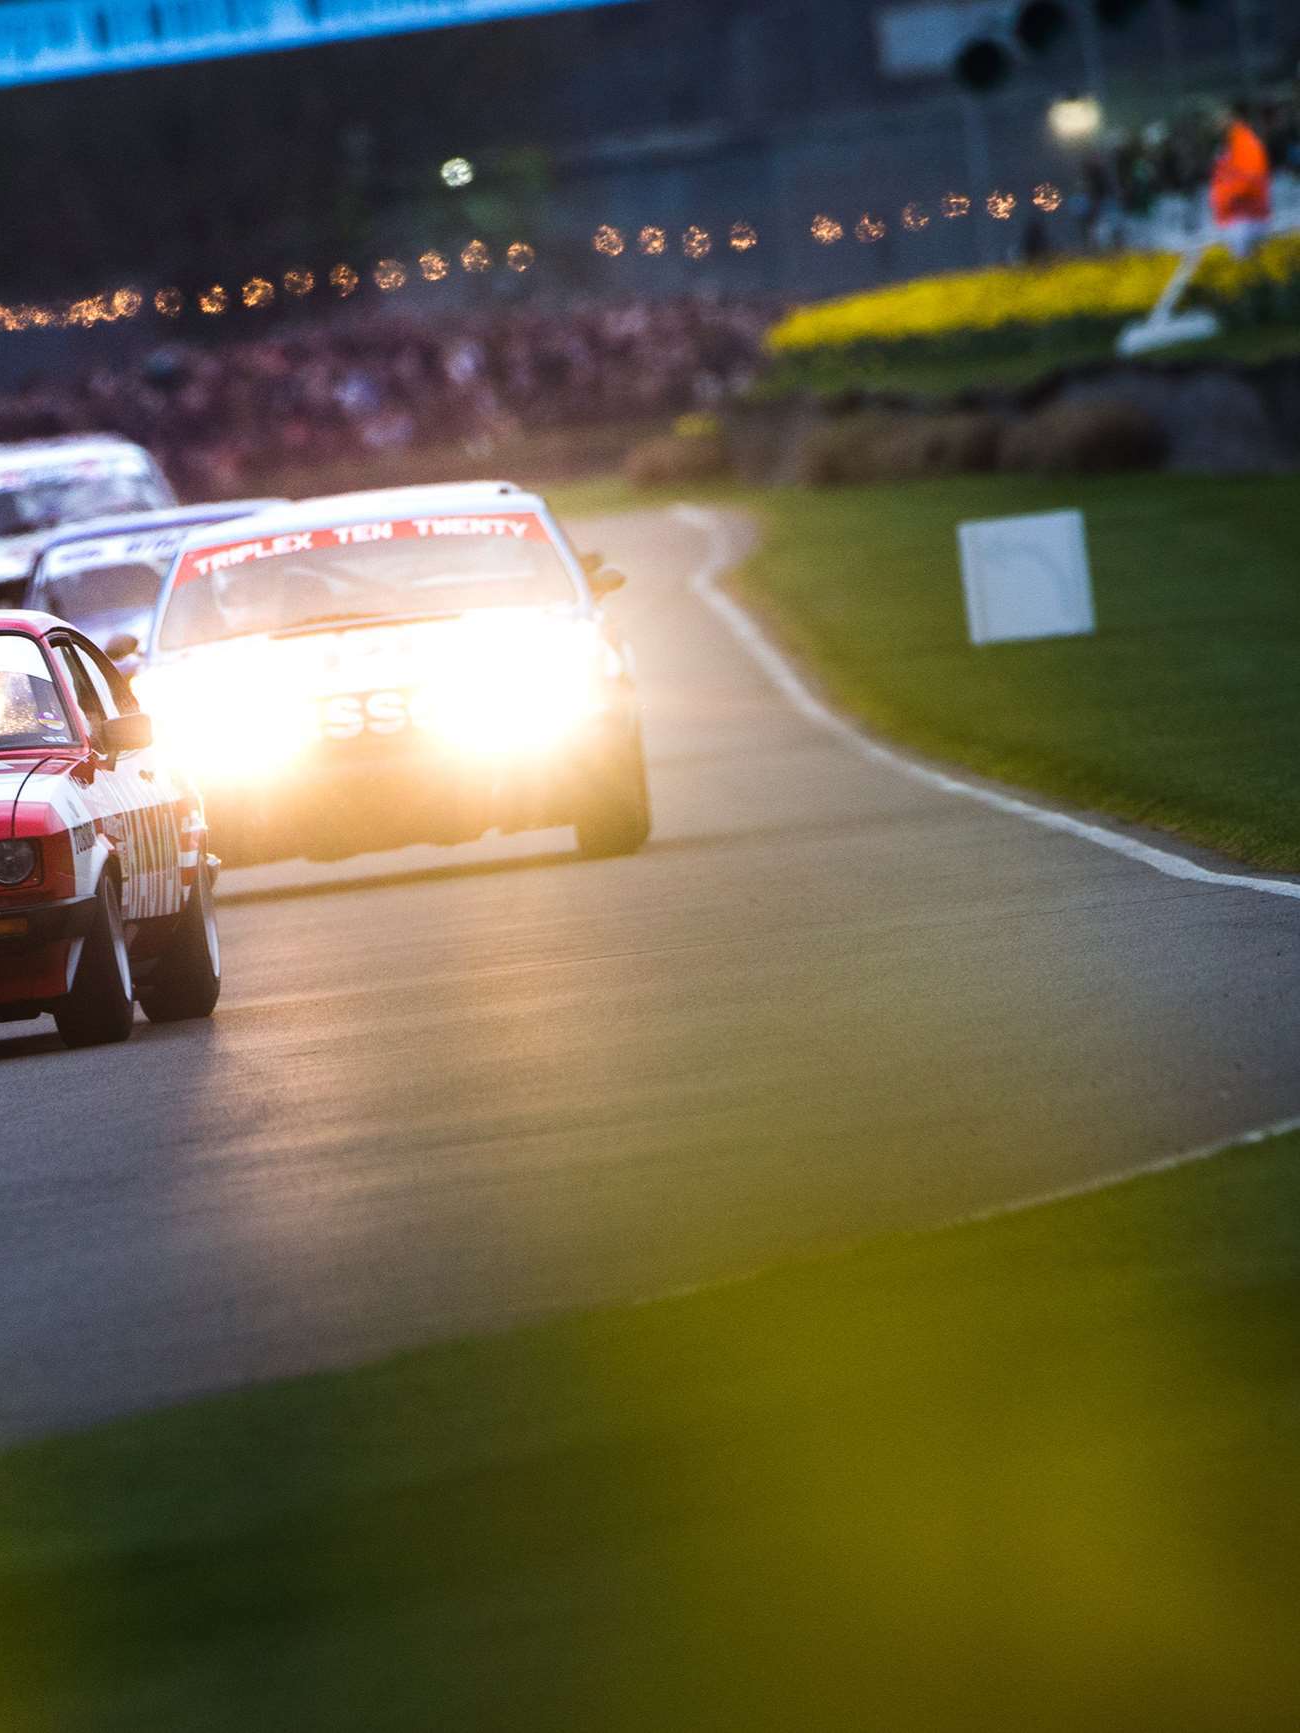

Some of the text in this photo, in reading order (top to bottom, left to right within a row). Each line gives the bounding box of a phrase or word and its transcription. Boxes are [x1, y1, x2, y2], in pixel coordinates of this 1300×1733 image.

[193, 533, 314, 576] TRIPLEX
[332, 522, 393, 545] TEN
[412, 517, 529, 538] TWENTY
